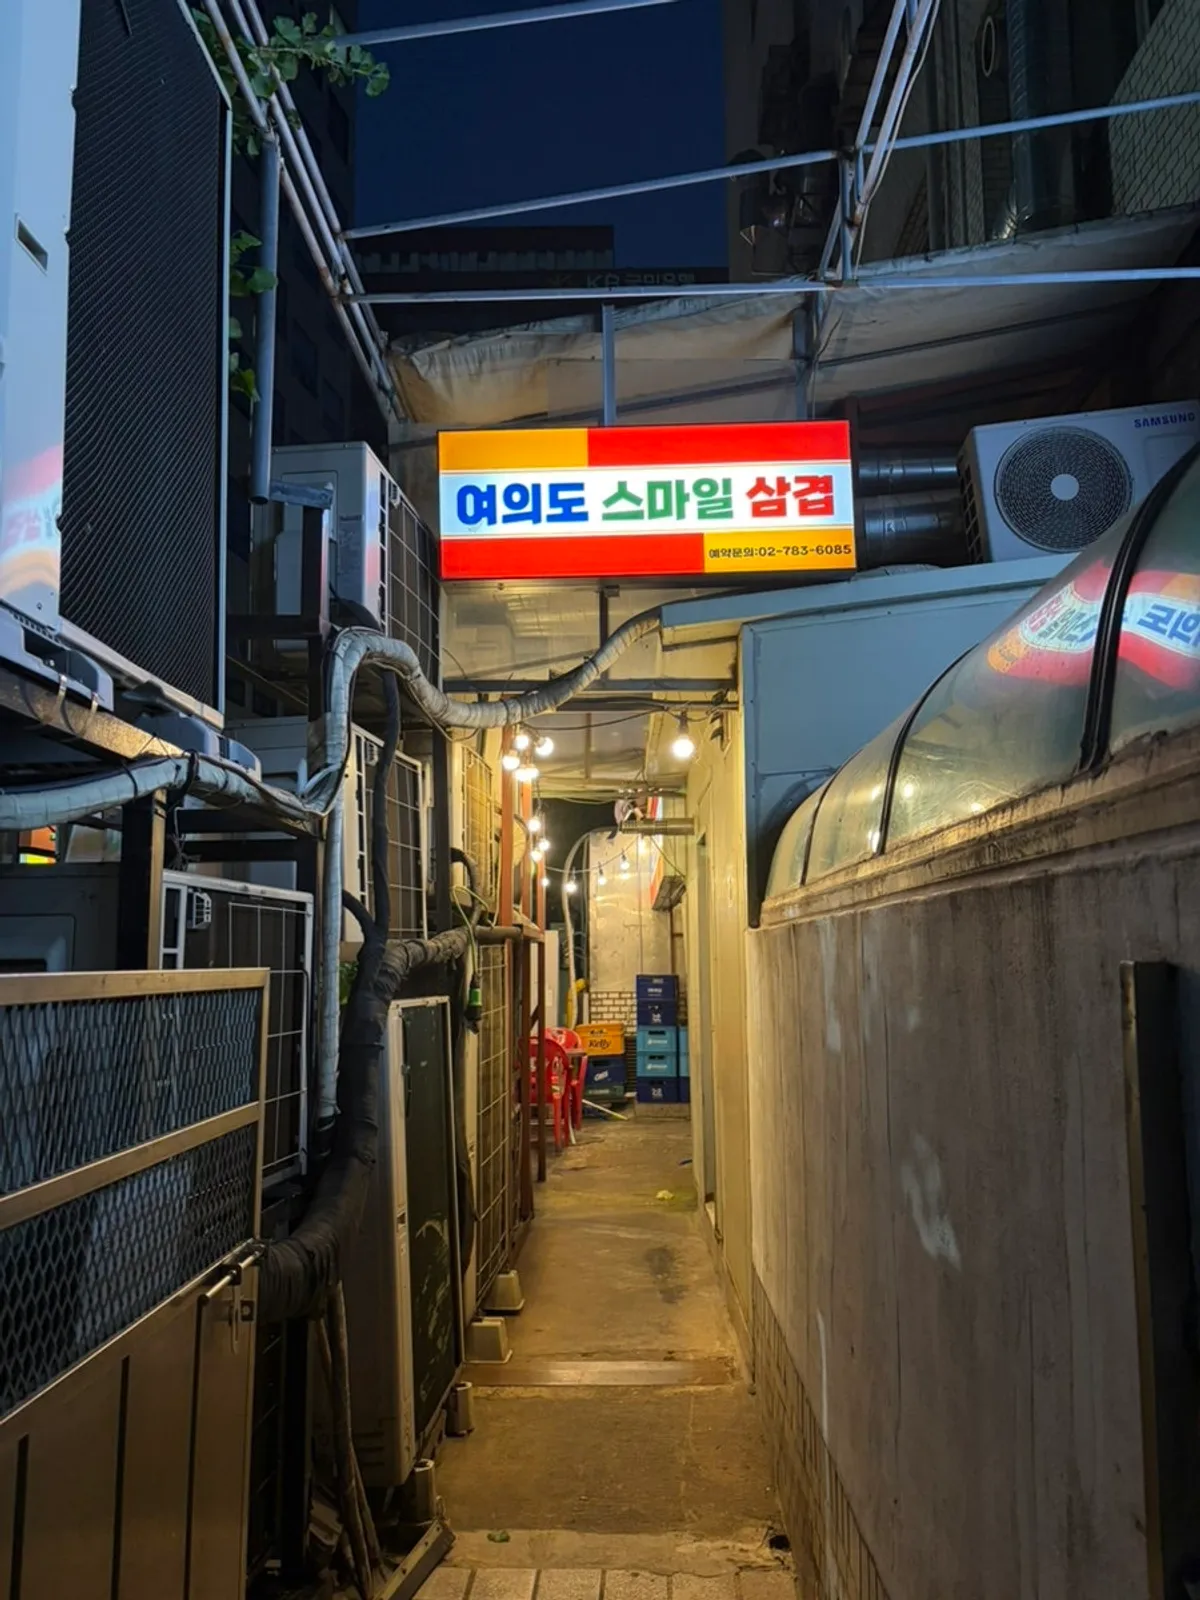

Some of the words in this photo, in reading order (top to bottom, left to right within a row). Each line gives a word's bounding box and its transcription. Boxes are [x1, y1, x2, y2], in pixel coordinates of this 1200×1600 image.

[1134, 412, 1196, 428] SAMSUNG
[456, 482, 589, 527] 여의도
[602, 477, 734, 522] 스마일
[746, 474, 835, 519] 삼겹
